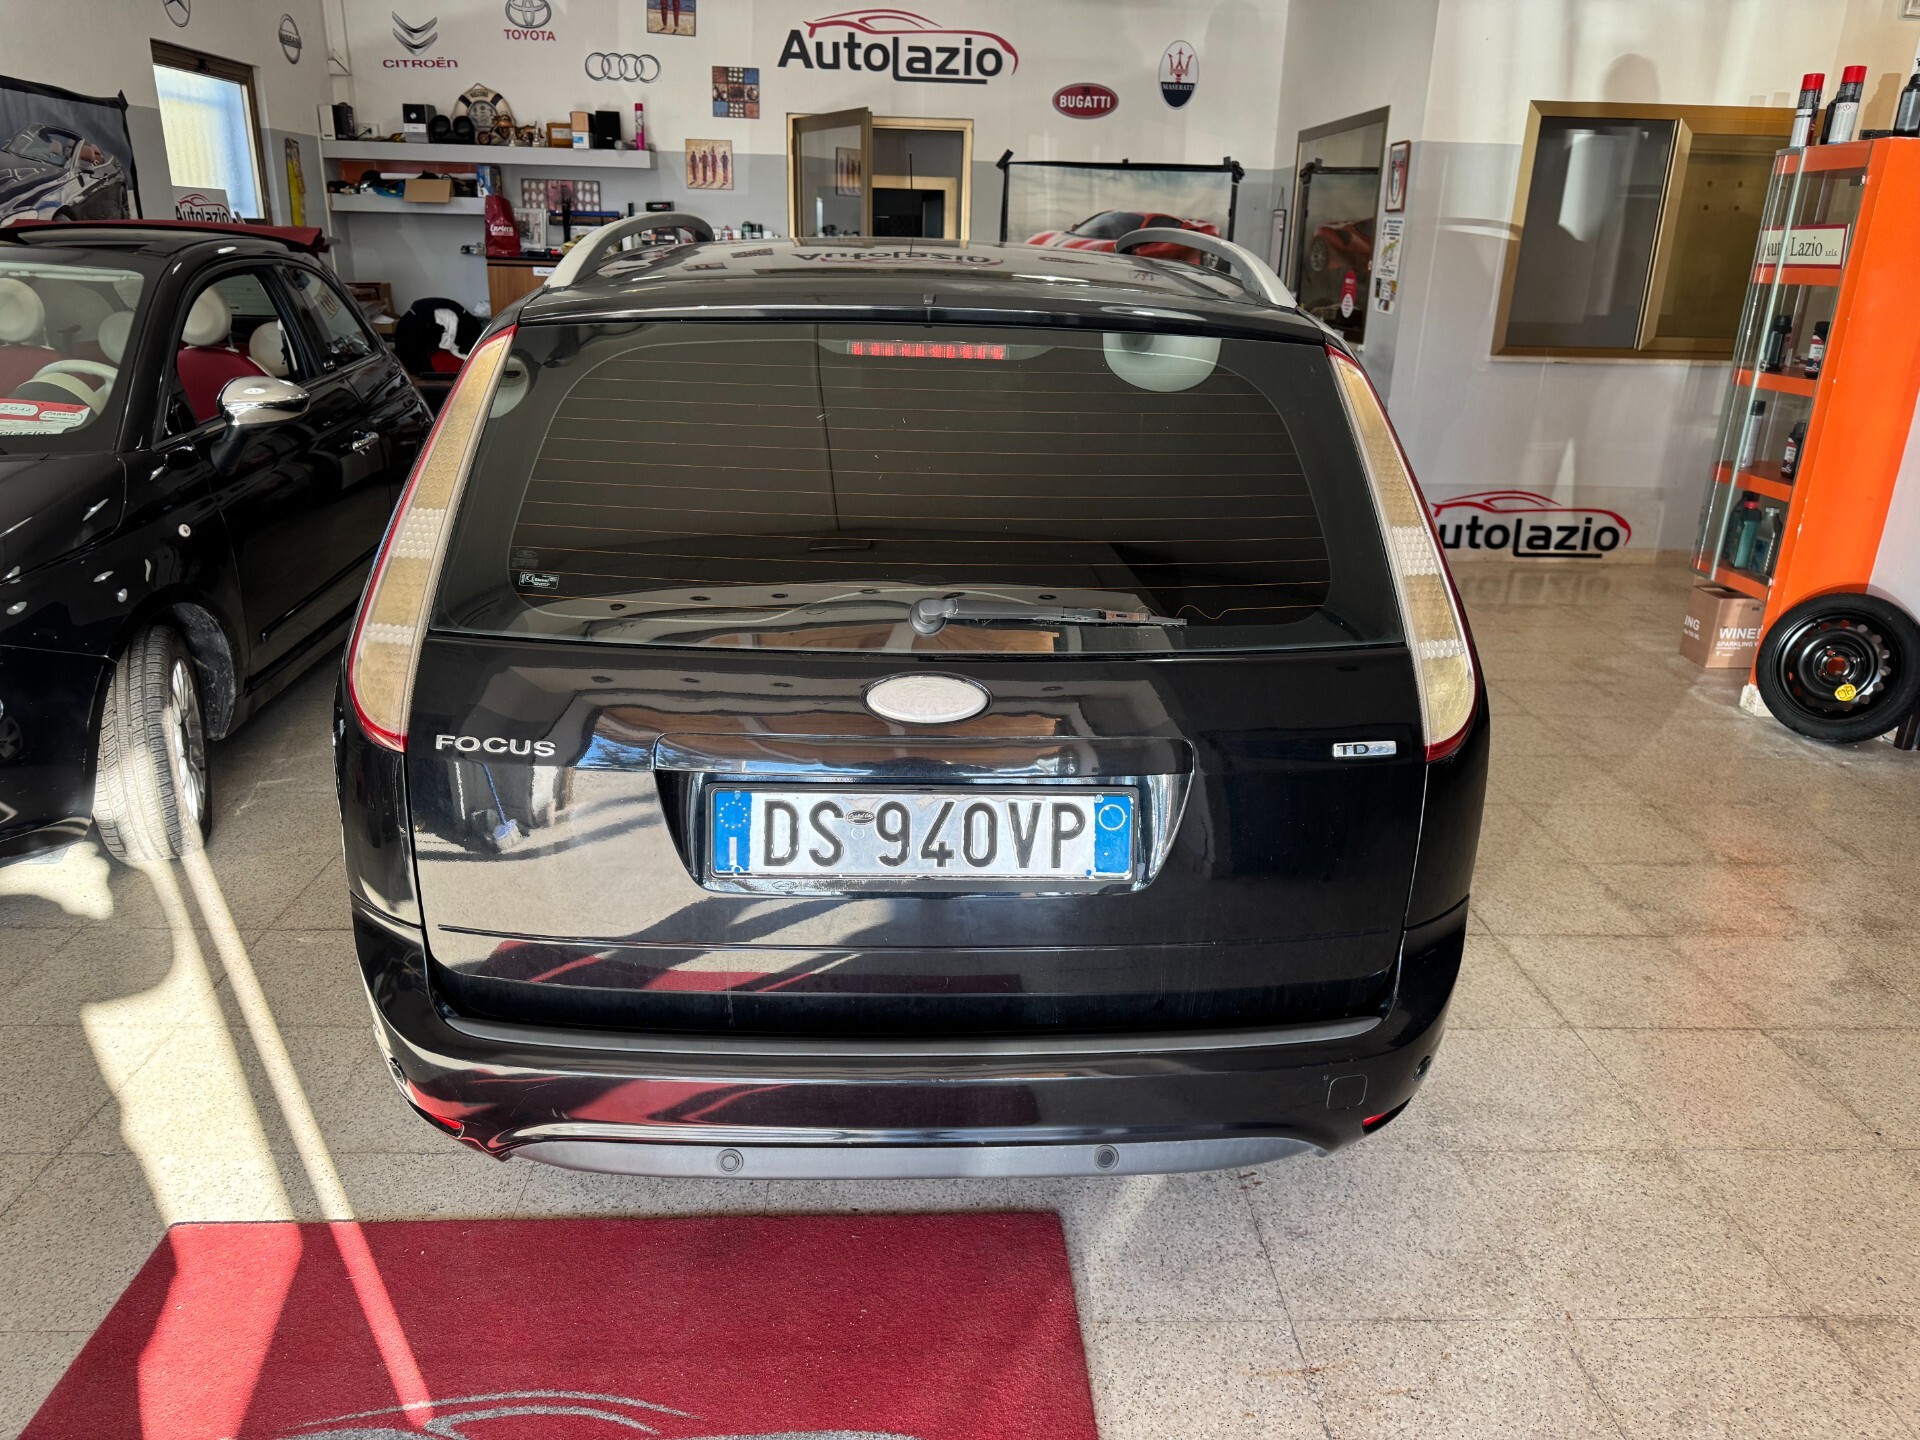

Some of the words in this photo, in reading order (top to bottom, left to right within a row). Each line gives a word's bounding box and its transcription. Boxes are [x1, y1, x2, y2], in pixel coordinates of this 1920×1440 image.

[504, 29, 556, 42] TOYOTA
[1059, 95, 1111, 108] BUGATTI
[1789, 236, 1823, 257] Lazio
[1439, 515, 1620, 558] utoLazio
[436, 734, 556, 757] FOCUS
[764, 800, 845, 867] DS
[876, 800, 1086, 869] 940VP
